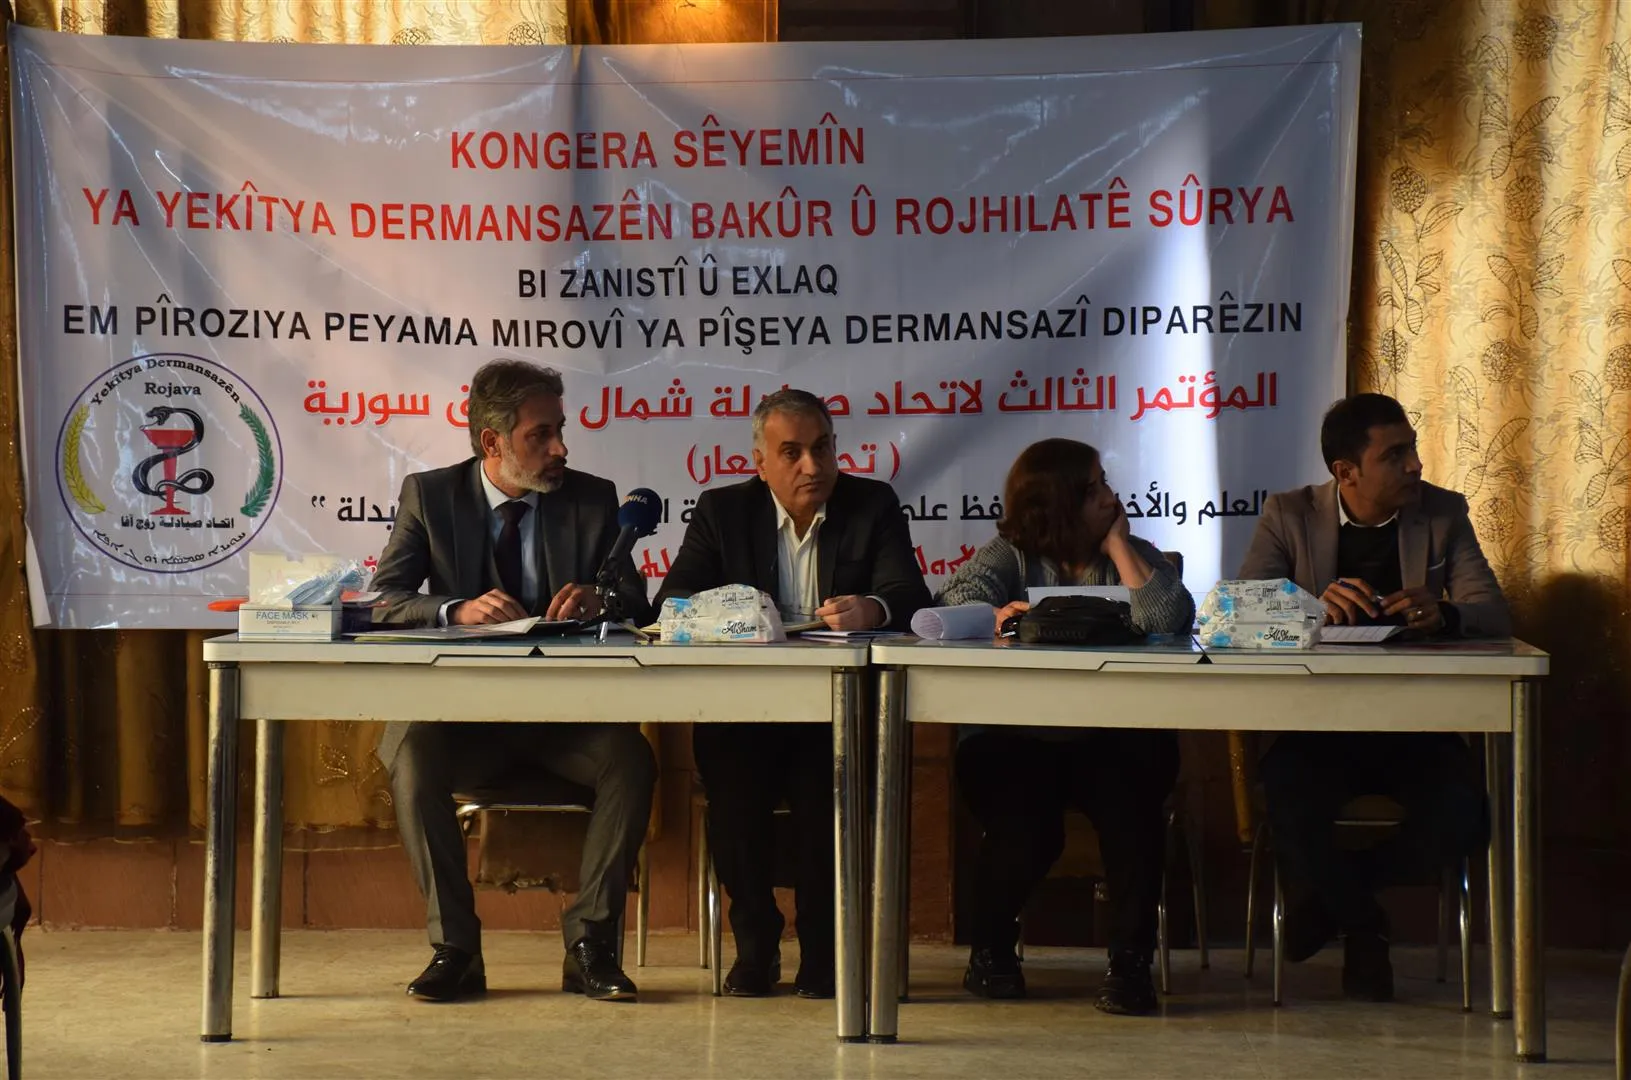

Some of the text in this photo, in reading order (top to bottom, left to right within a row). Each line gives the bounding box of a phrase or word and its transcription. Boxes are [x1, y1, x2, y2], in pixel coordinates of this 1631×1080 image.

[450, 112, 865, 171] KONGERA SÊYEMÎN
[82, 173, 1295, 242] YA YEKÎTYA DERMANSAZÊN BAKÛR Û ROJHILATÊ SÛRYA
[518, 254, 838, 298] BI ZANISTÎ Û EXLAQ
[64, 291, 1302, 355] EM PÎROZIYA PEYAMA MIROVÎ YA PÎŞEYA DERMANSAZÎ DIPARÊZIN
[144, 382, 202, 398] Rojava
[303, 380, 431, 426] سورية
[579, 378, 692, 430] شمال
[867, 378, 984, 416] لاتحاد
[998, 367, 1117, 412] الثالث
[1130, 370, 1278, 421] المؤتمر
[1198, 489, 1267, 525] العلم
[256, 611, 309, 620] FACE MASK
